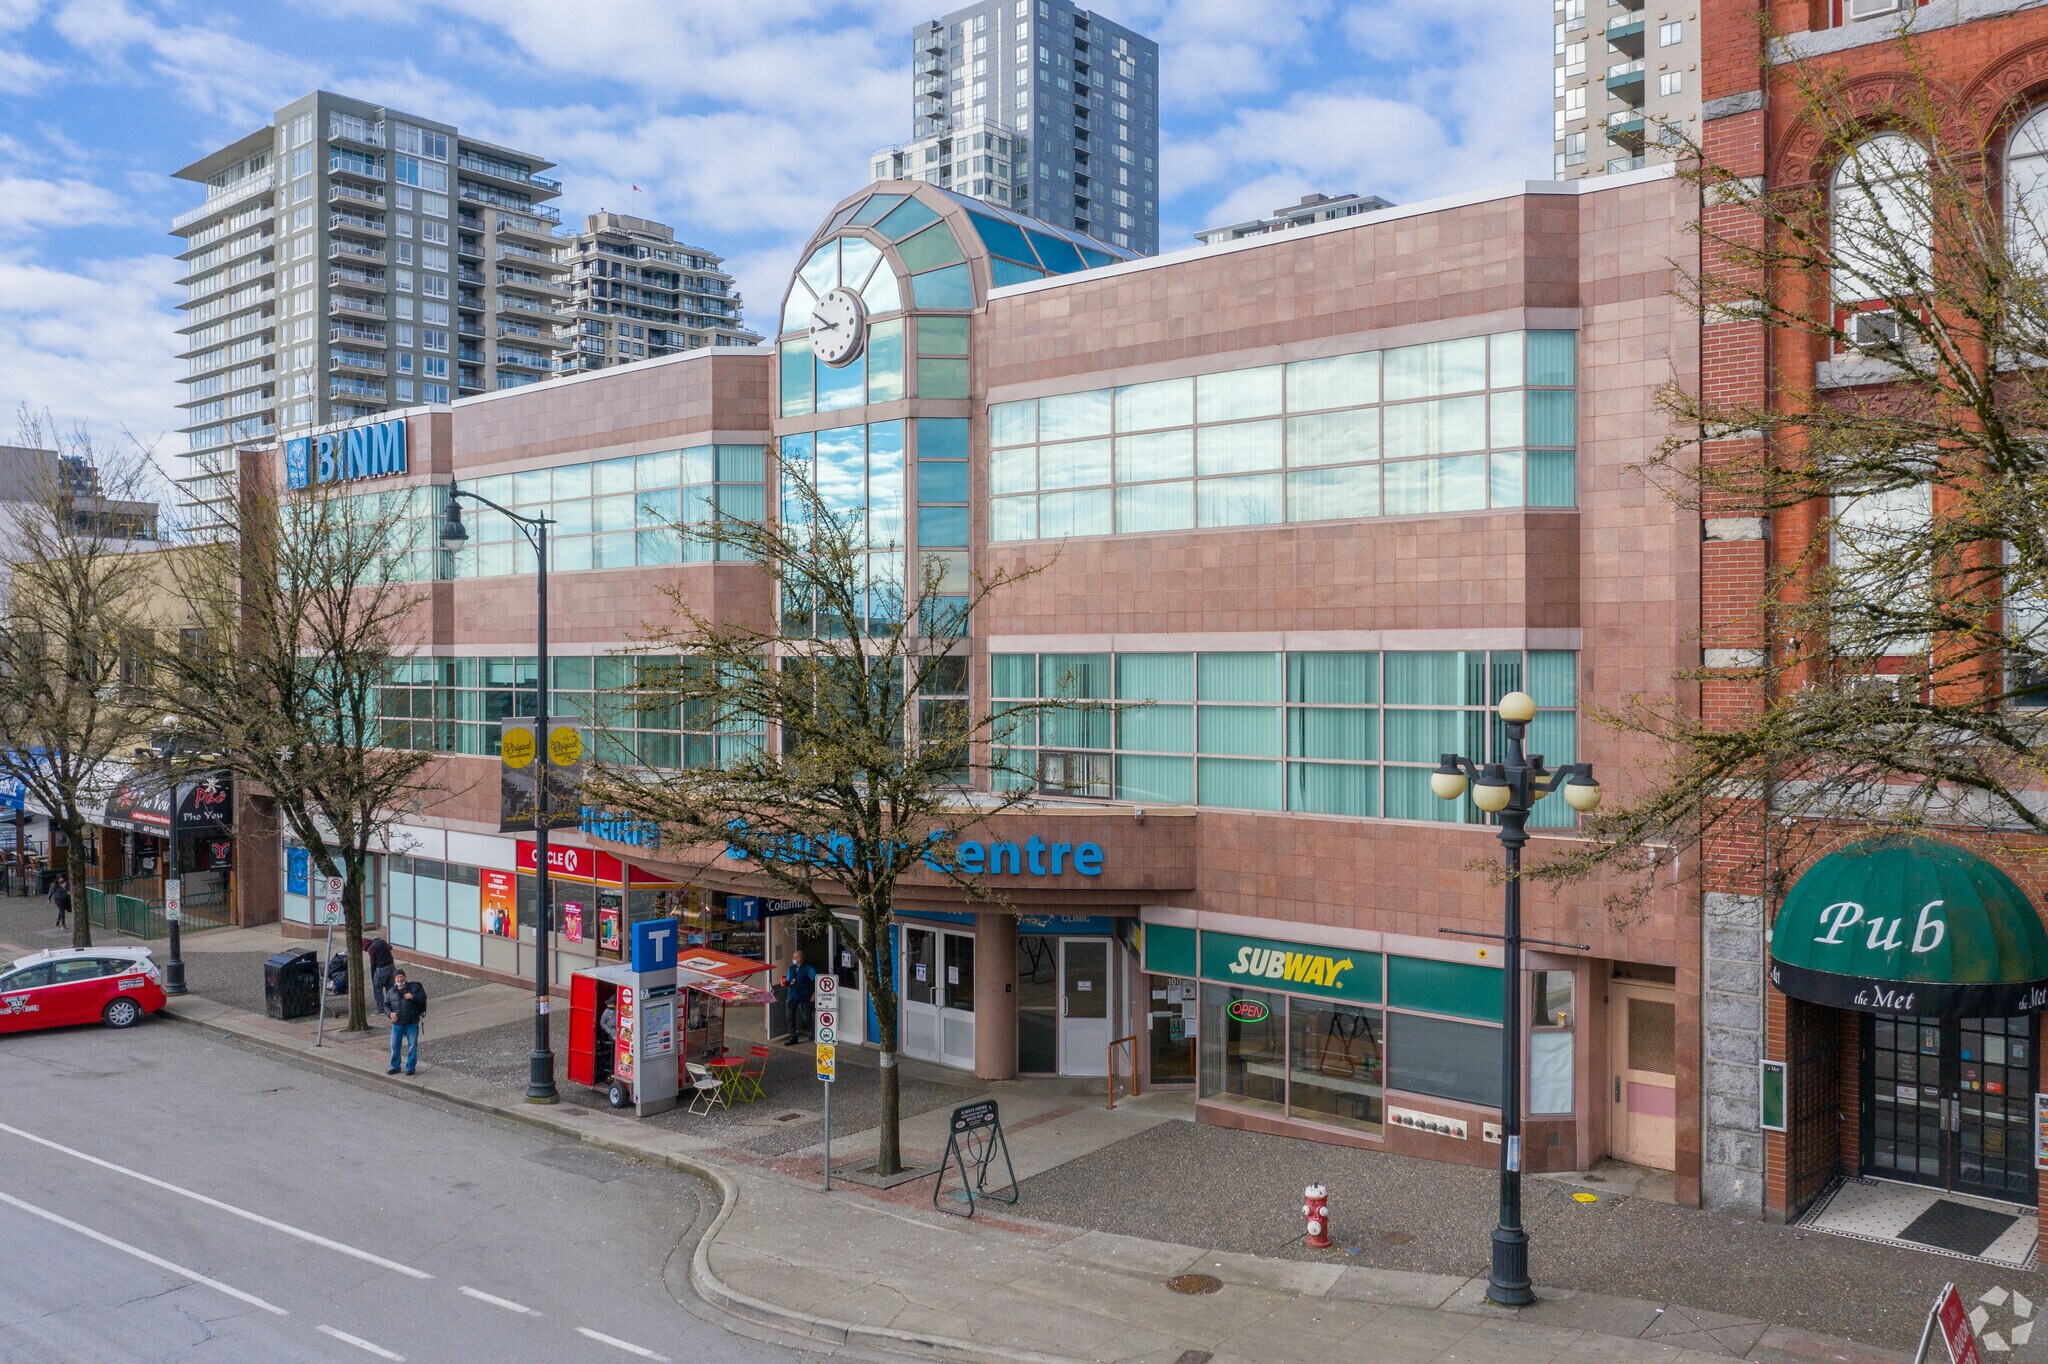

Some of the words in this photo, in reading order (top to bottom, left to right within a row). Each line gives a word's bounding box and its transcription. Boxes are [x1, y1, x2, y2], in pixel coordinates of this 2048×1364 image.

[503, 740, 532, 755] Original
[183, 811, 202, 822] Pho
[203, 810, 223, 821] You
[531, 848, 564, 866] CCLE
[922, 828, 1104, 876] Centre
[744, 901, 755, 917] T
[1061, 914, 1091, 924] CLINIC
[1813, 900, 1945, 953] Pub
[648, 929, 671, 963] T
[1229, 946, 1354, 987] SUBWAY
[1168, 978, 1182, 986] 100
[1854, 990, 1868, 1007] the
[1871, 984, 1915, 1010] Met
[1232, 1002, 1263, 1019] OPEN
